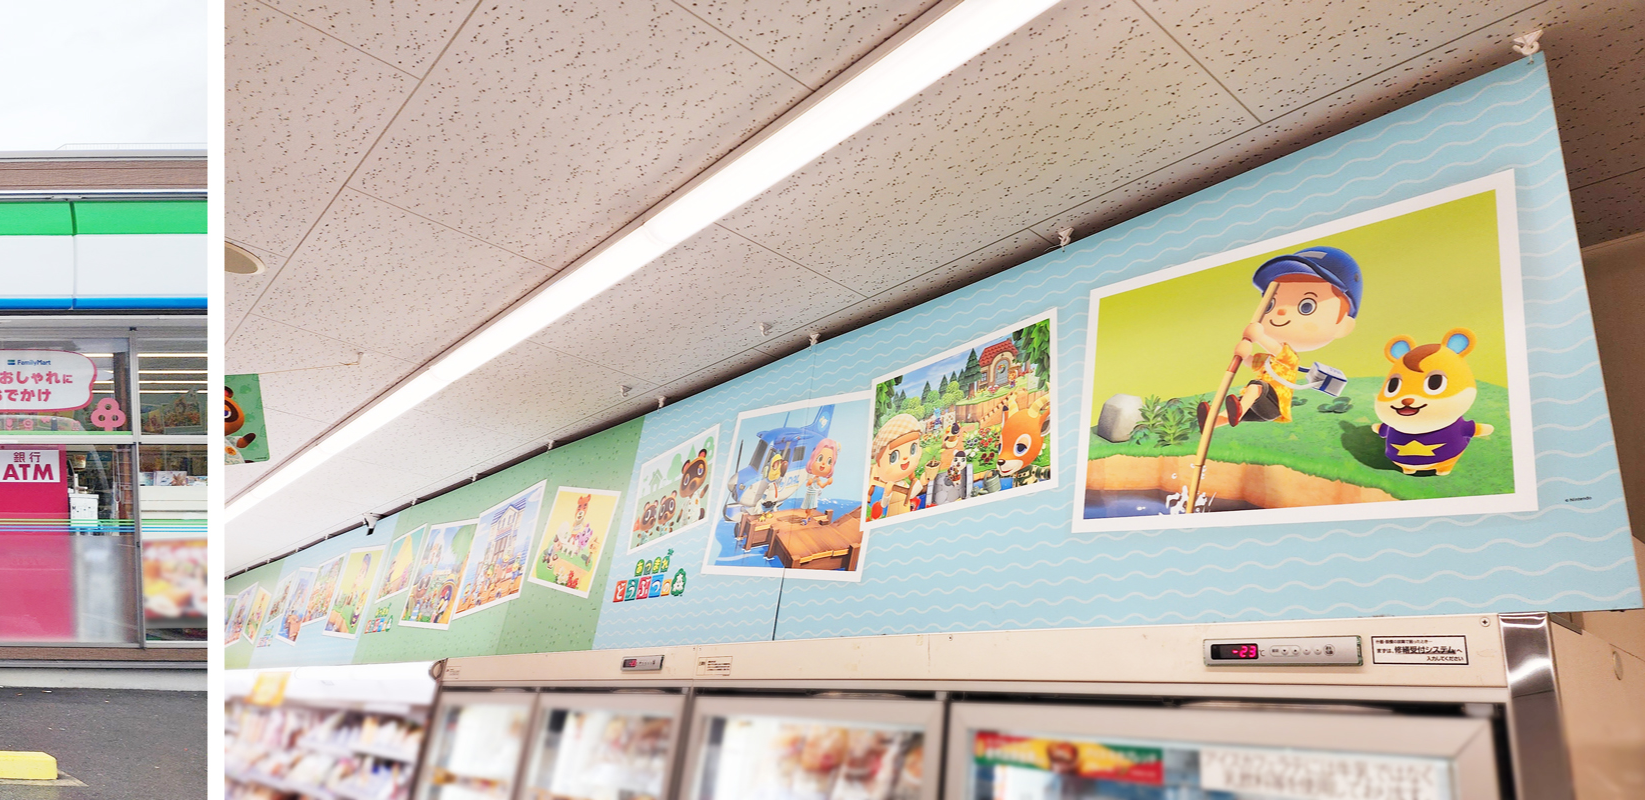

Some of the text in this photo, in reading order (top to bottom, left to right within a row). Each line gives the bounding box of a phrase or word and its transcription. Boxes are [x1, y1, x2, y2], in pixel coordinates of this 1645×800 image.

[13, 451, 41, 463] 銀行
[2, 463, 55, 481] ATM
[635, 557, 670, 575] あつまれ
[615, 570, 685, 601] どうぶつの森
[1232, 645, 1256, 658] -23
